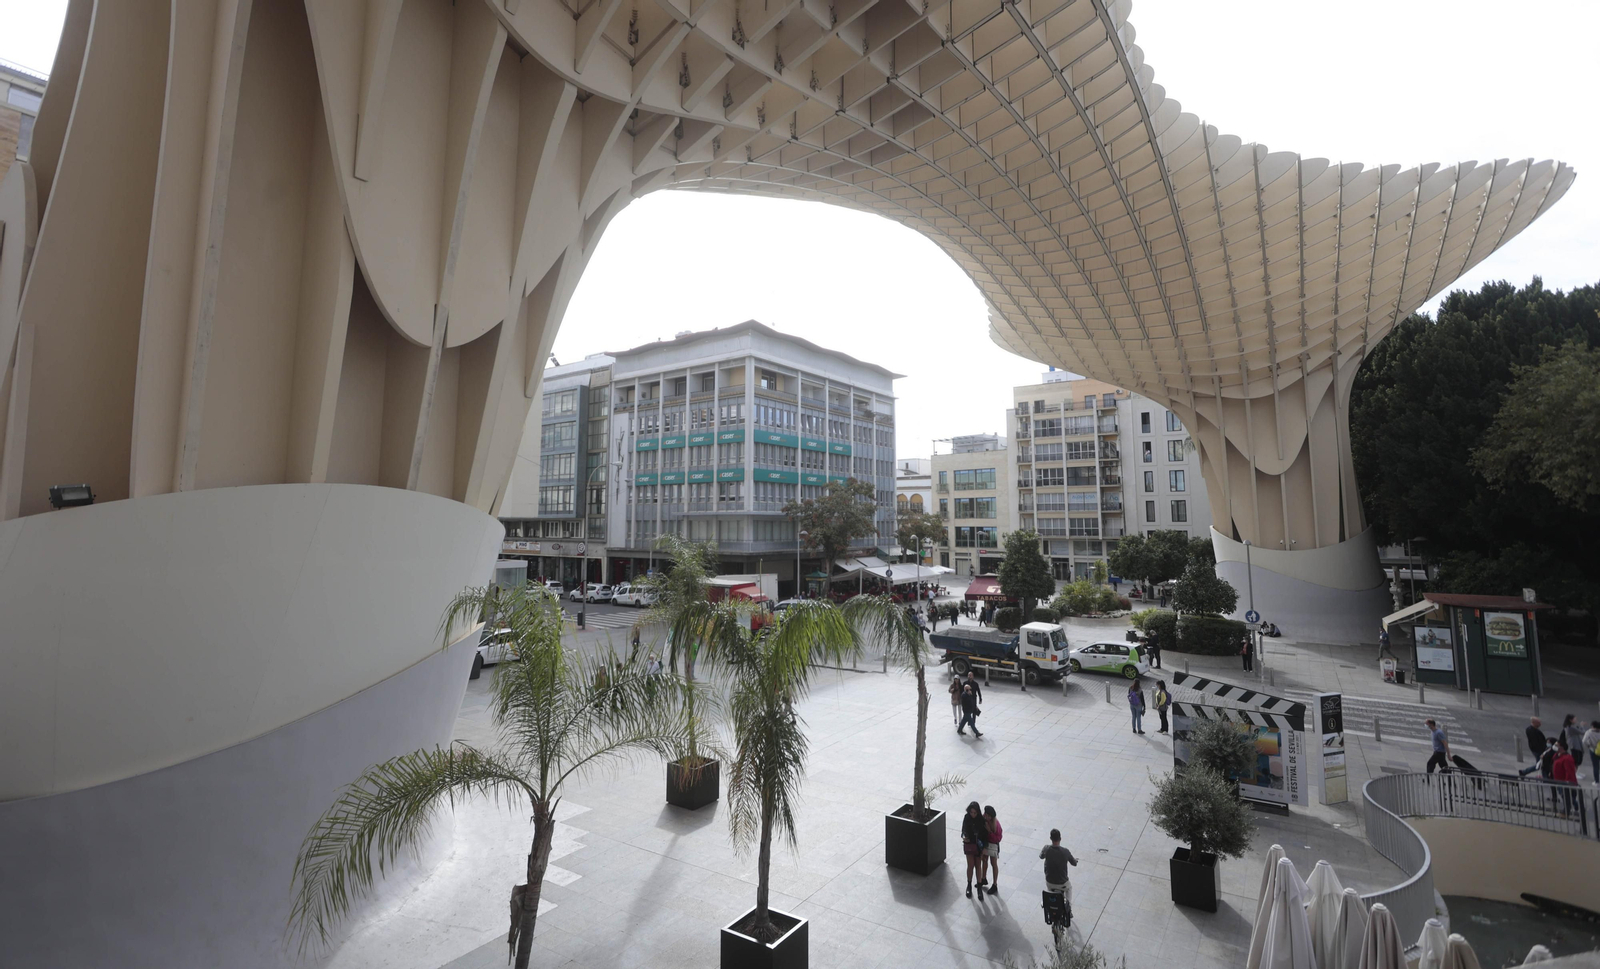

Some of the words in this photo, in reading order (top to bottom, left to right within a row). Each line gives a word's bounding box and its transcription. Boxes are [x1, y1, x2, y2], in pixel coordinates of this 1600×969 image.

[1288, 730, 1296, 754] SEVILLA
[1289, 755, 1296, 764] DE
[1290, 766, 1298, 793] FESTIVAL
[1291, 794, 1298, 803] 18
